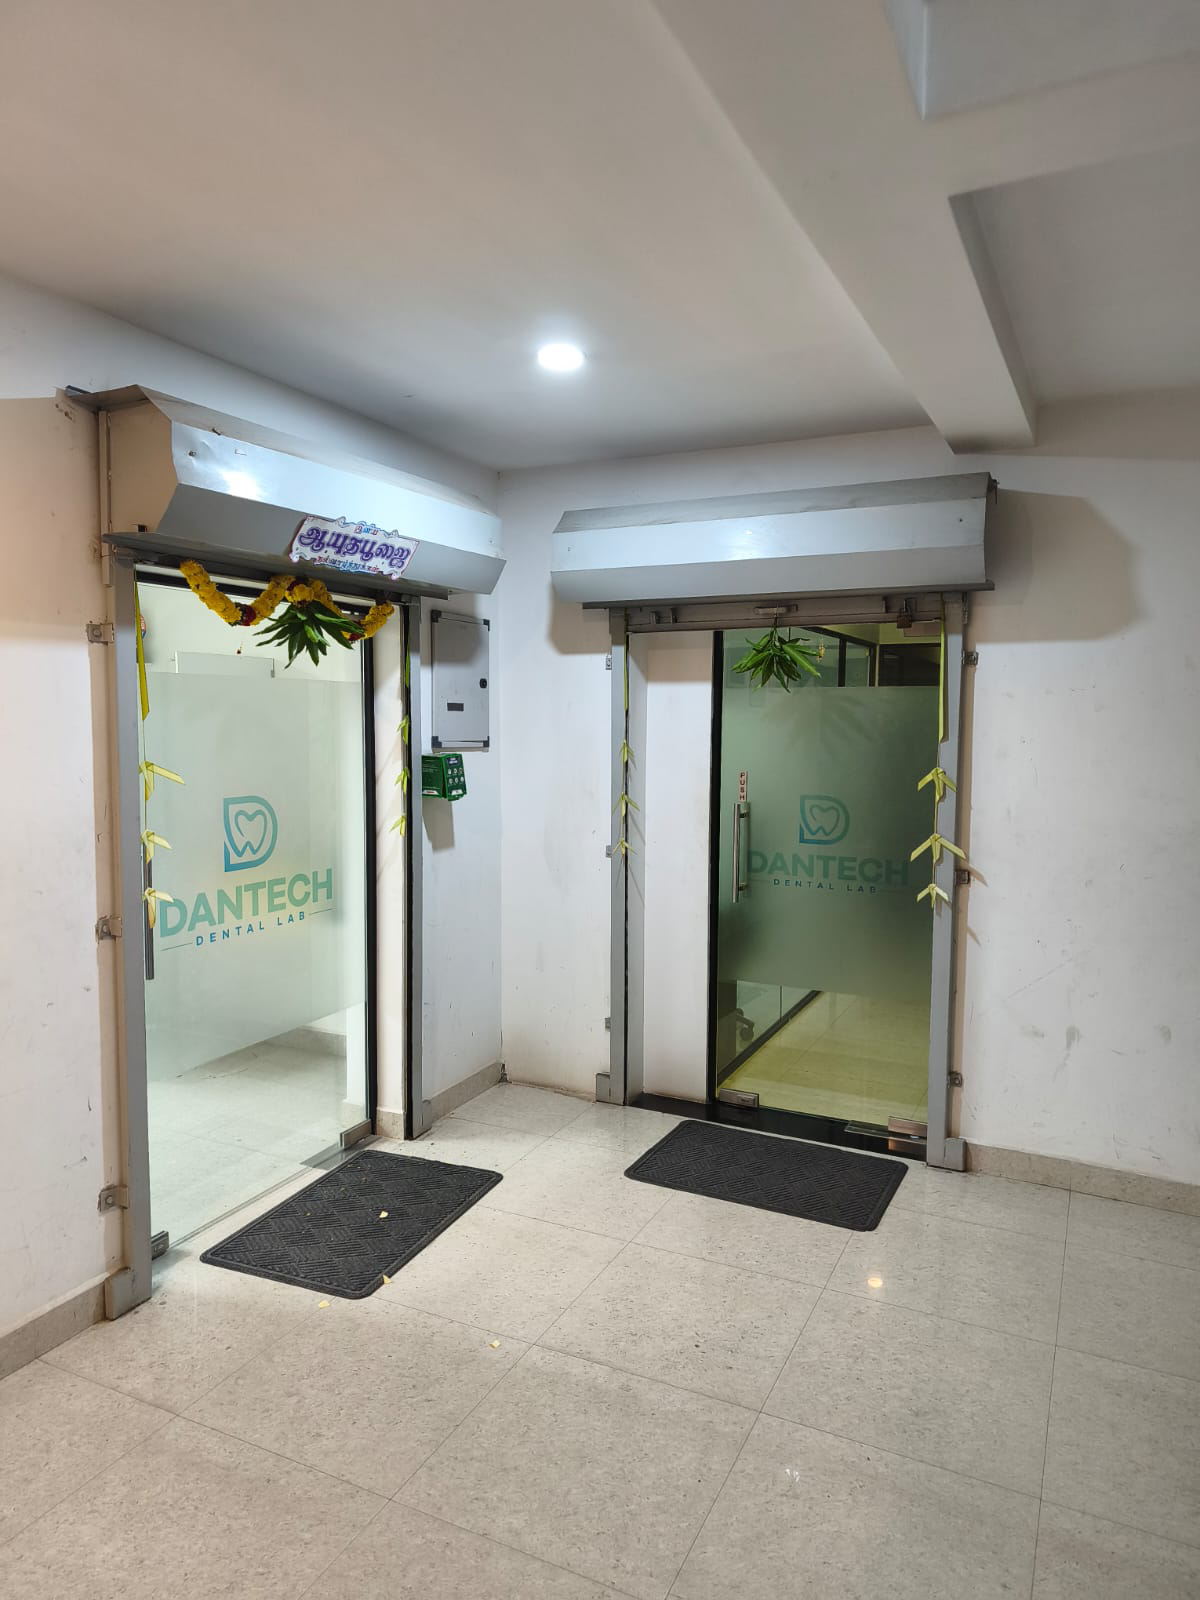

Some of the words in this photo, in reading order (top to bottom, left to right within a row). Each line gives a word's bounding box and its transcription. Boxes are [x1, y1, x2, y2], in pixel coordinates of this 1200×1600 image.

[748, 851, 909, 885] DANTECH
[159, 868, 333, 938] DANTECH
[773, 878, 834, 890] DENTAL
[847, 884, 877, 894] LAB
[195, 921, 265, 946] DENTAL
[277, 911, 305, 926] LAB
